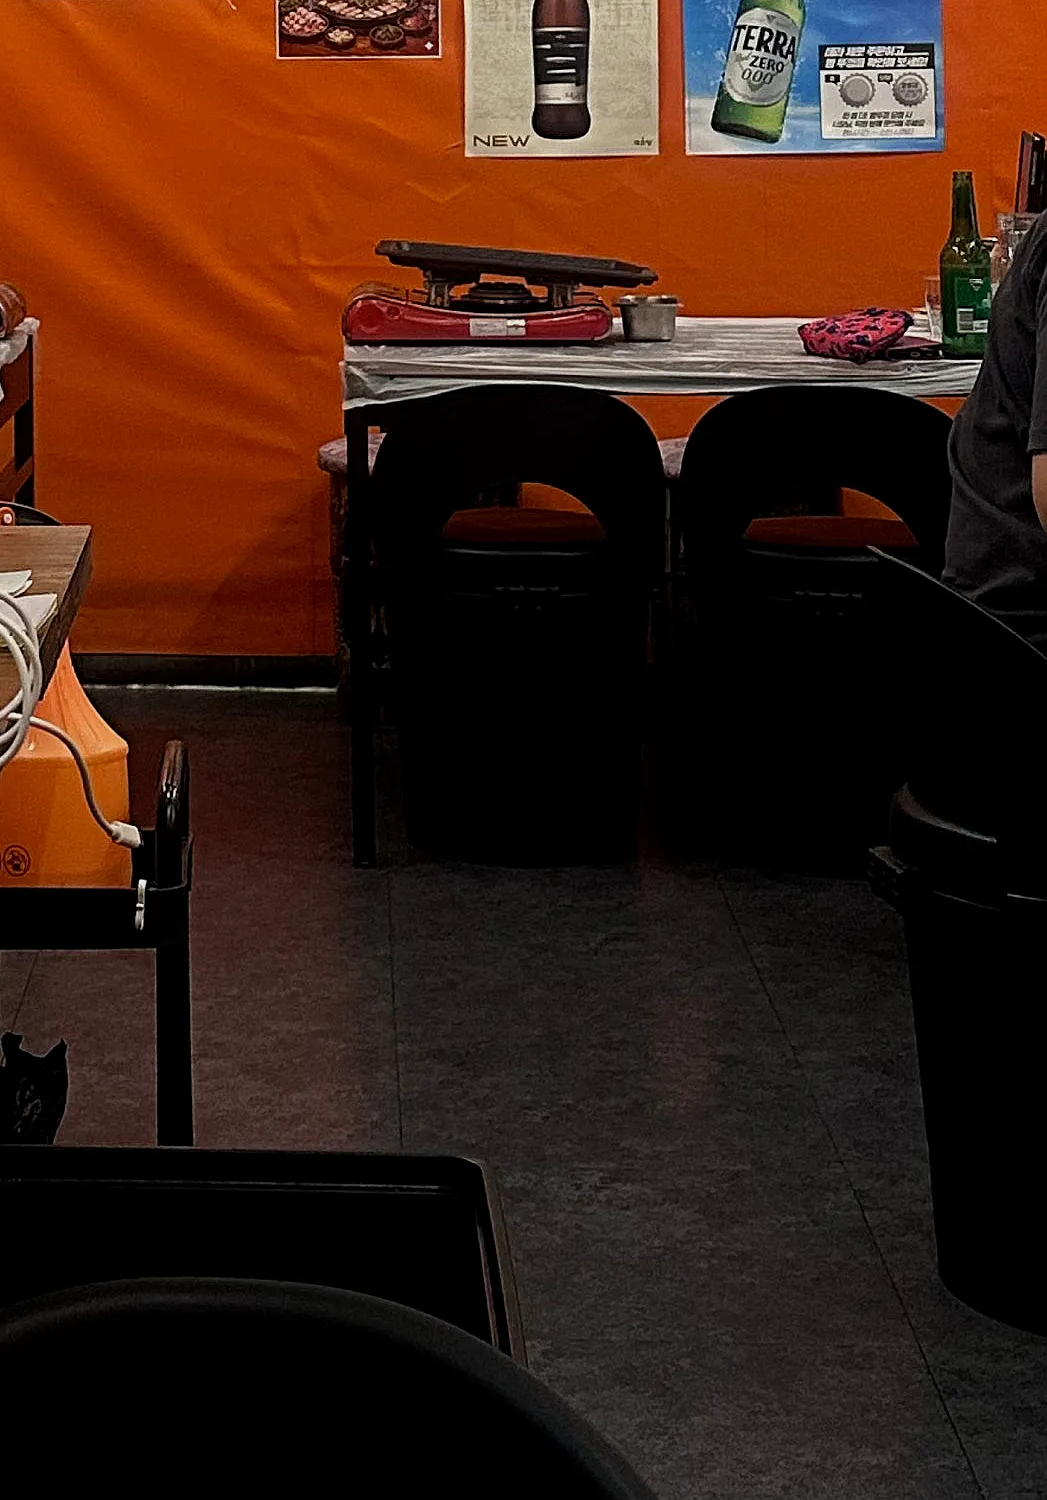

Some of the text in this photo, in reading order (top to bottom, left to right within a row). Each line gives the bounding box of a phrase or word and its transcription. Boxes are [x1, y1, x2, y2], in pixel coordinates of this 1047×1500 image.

[733, 25, 796, 62] TERRA
[749, 55, 784, 73] ZERO
[473, 135, 530, 146] NEW
